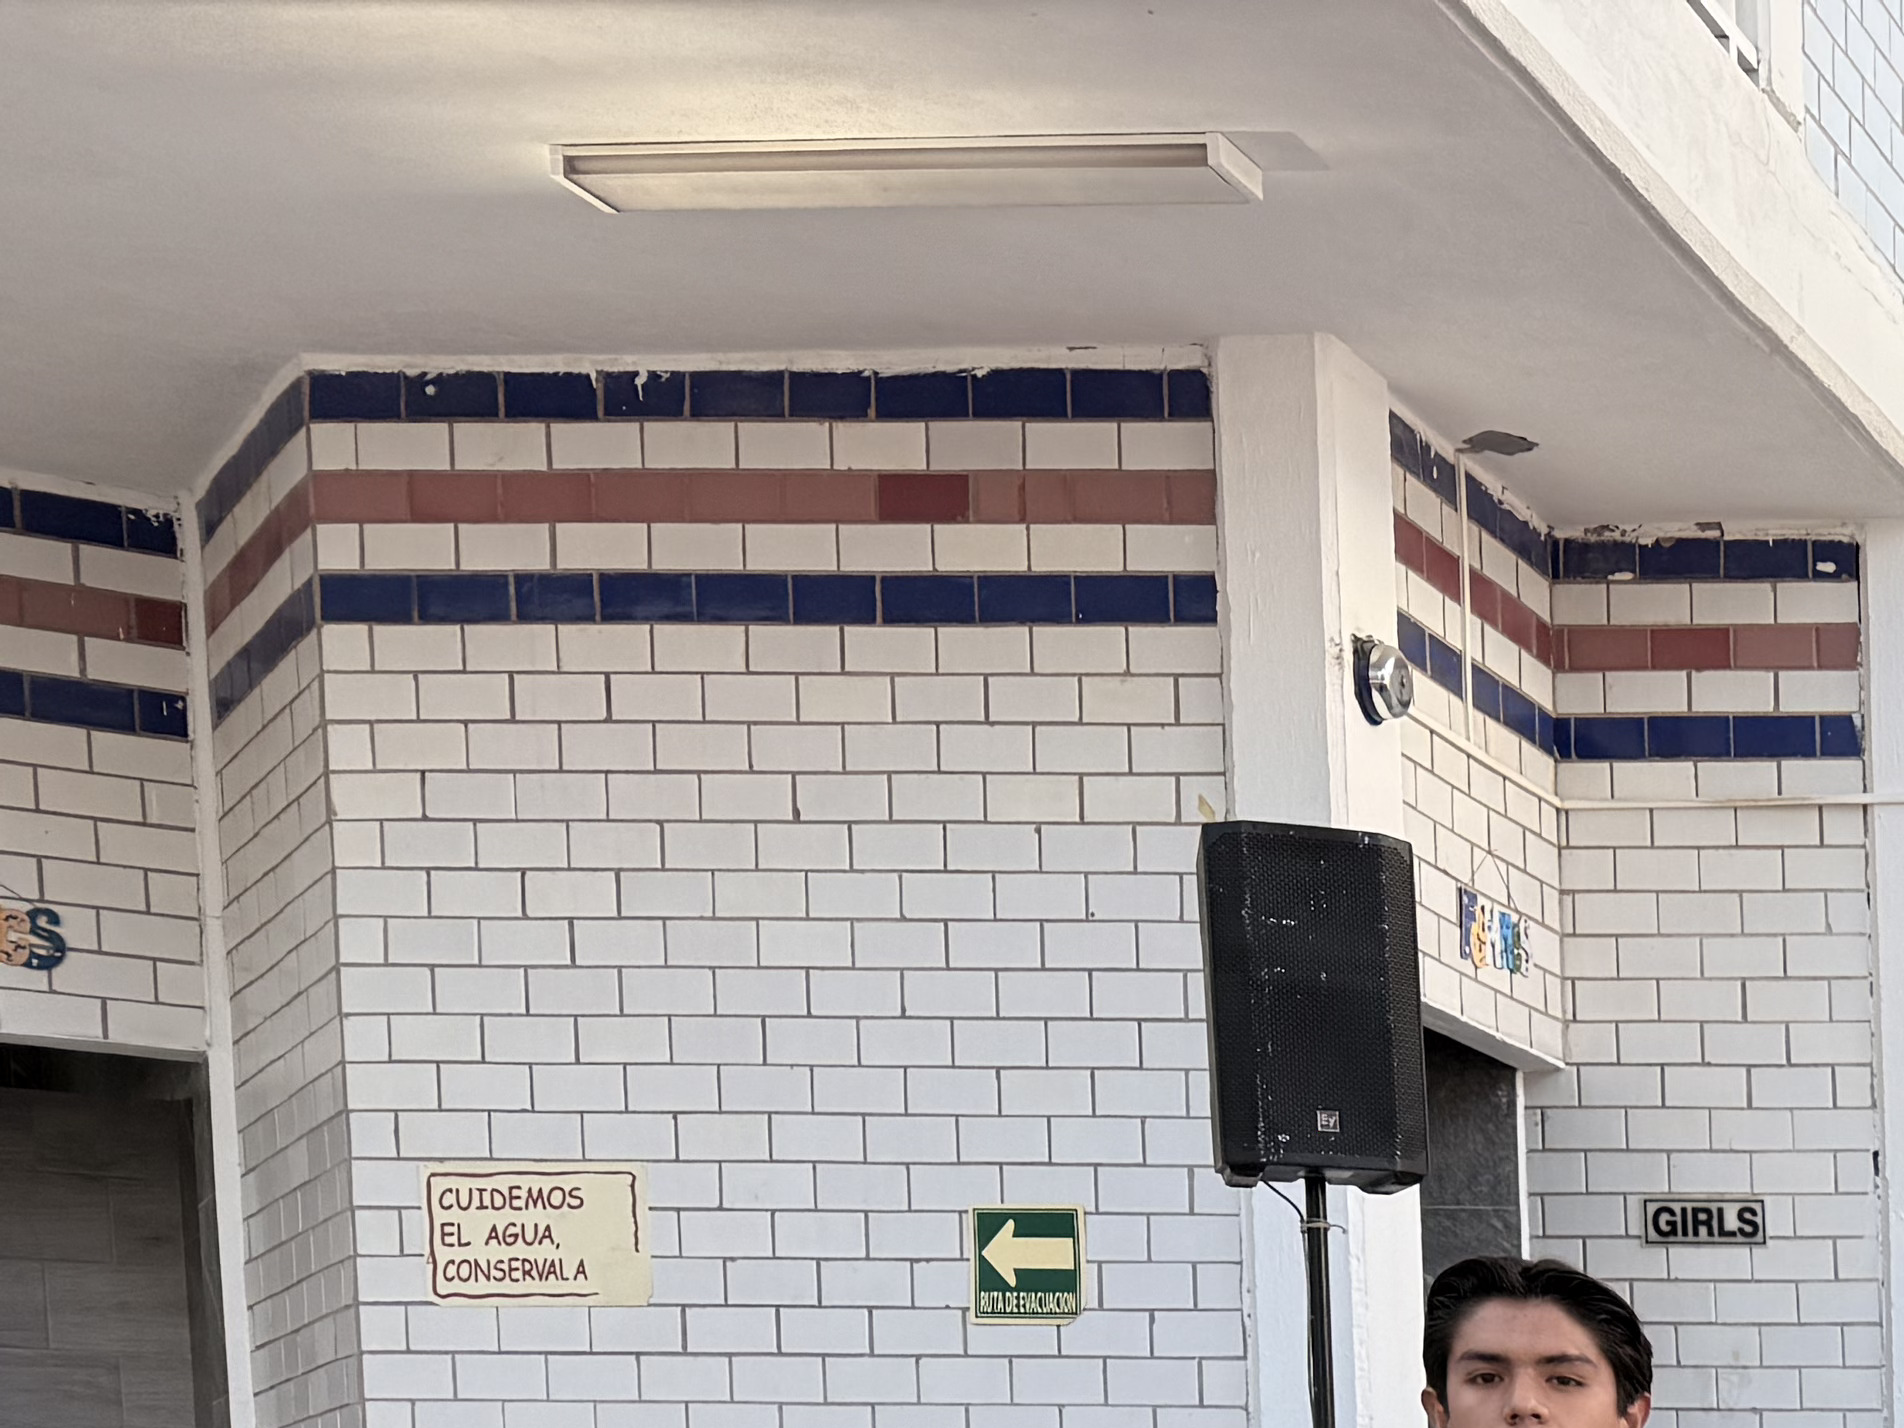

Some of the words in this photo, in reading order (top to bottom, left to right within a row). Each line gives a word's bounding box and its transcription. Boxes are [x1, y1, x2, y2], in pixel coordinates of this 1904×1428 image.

[438, 1185, 585, 1211] CUIDEMOS
[1652, 1205, 1760, 1238] GIRLS
[440, 1222, 471, 1248] EL
[484, 1222, 560, 1250] AGUA,
[442, 1258, 588, 1283] CONSERVALA
[980, 1291, 1004, 1313] RUTA
[1005, 1291, 1018, 1313] DE
